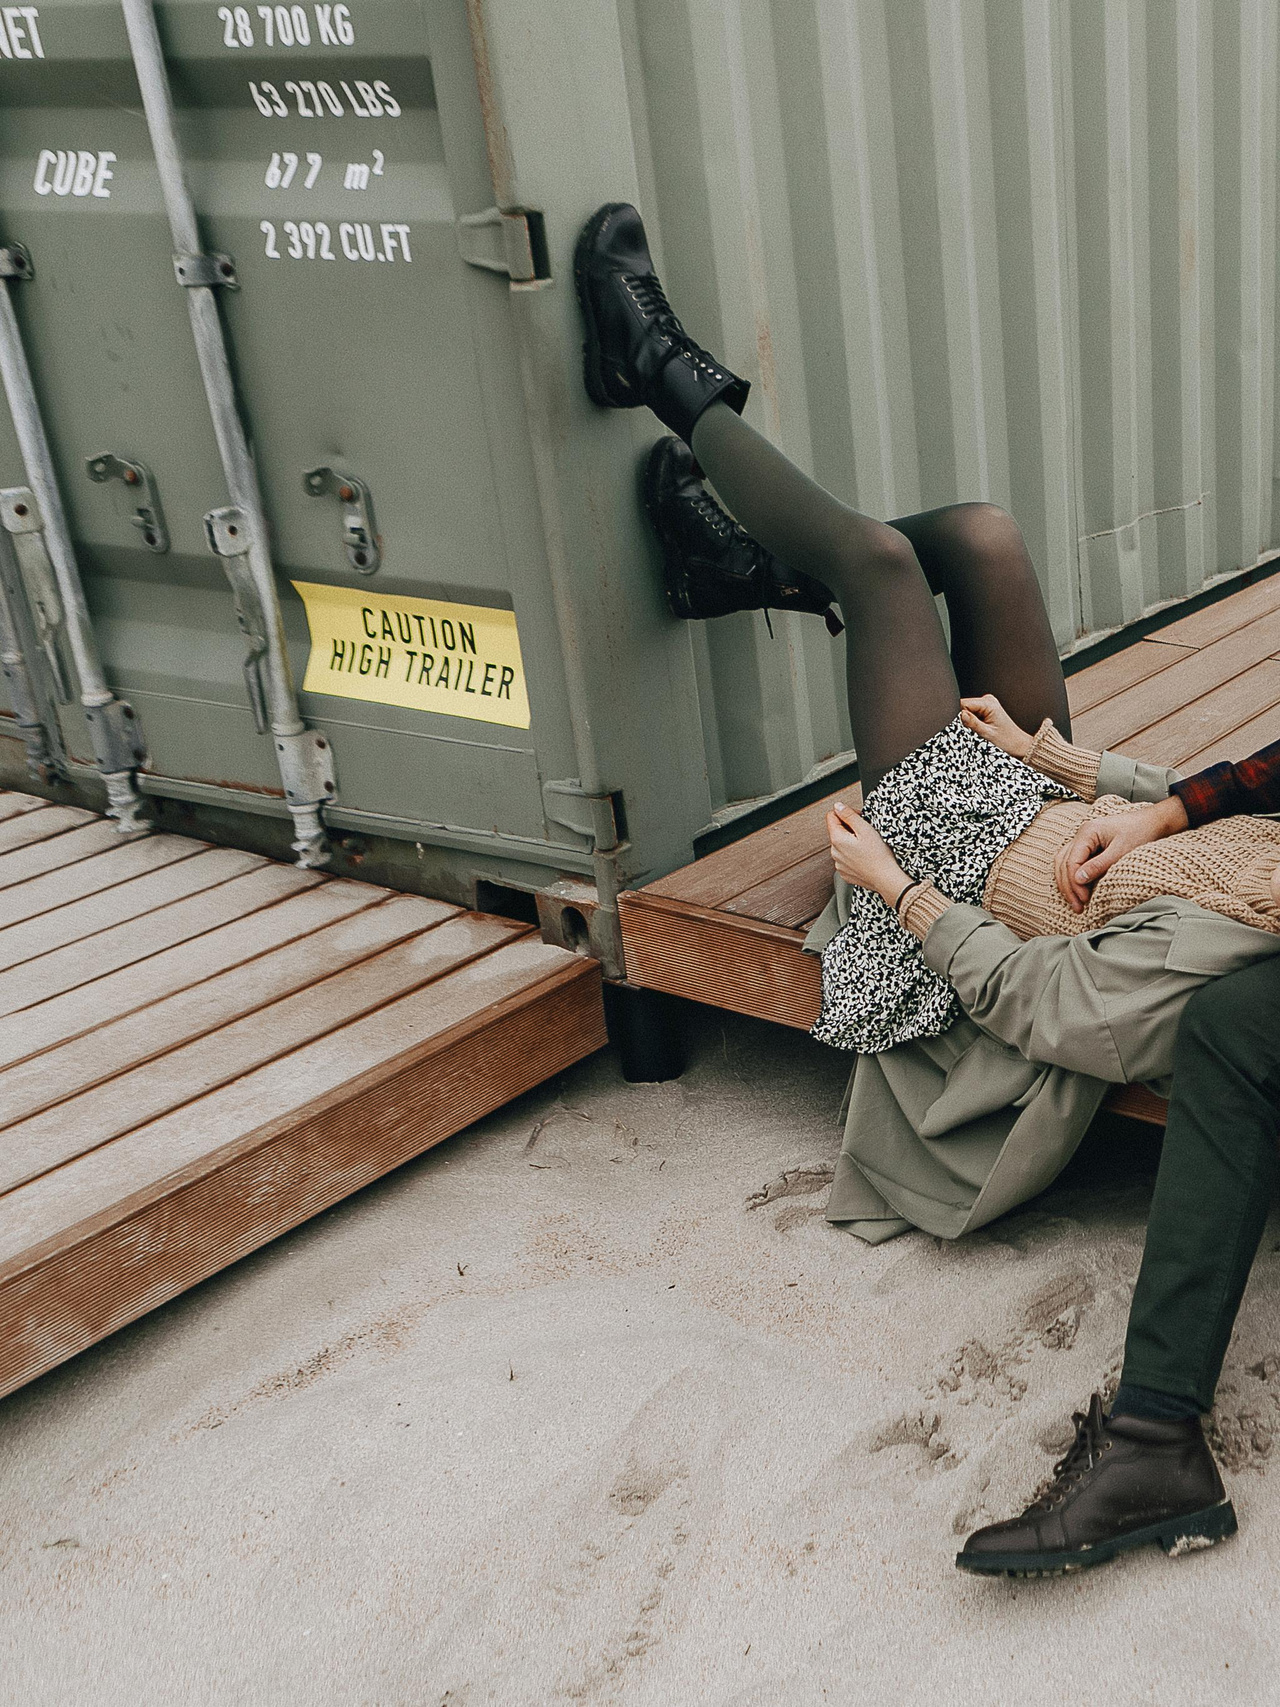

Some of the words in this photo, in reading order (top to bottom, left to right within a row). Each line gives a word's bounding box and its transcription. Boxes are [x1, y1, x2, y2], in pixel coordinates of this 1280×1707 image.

[218, 6, 254, 48] 28
[257, 5, 311, 46] 700
[314, 4, 355, 46] KG
[248, 80, 289, 118] 63
[284, 80, 345, 118] 270
[339, 80, 402, 118] LBS
[33, 149, 118, 198] CUBE
[260, 220, 281, 259] 2
[283, 221, 336, 260] 392
[339, 222, 412, 263] CU.FT
[362, 607, 477, 655] CAUTION
[330, 638, 391, 678] HIGH
[404, 650, 515, 700] TRAILER
